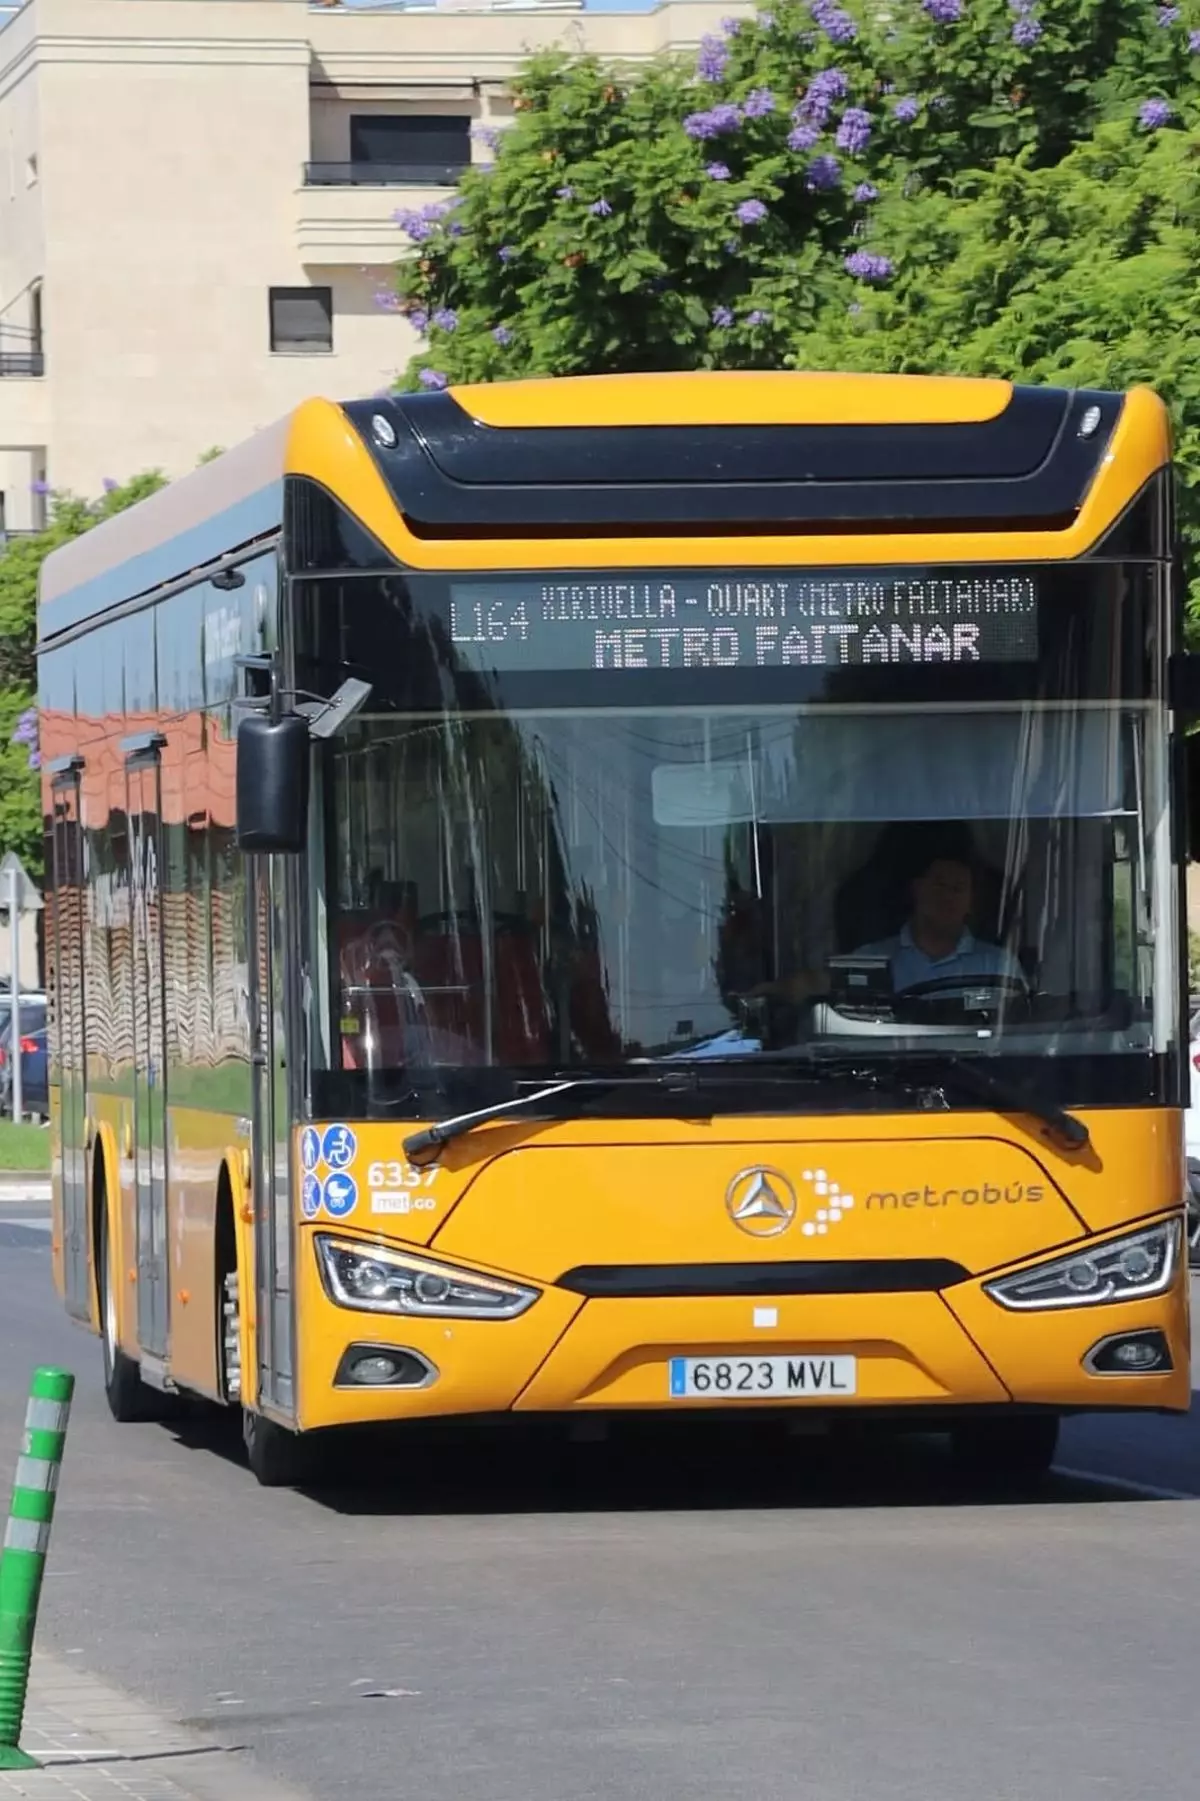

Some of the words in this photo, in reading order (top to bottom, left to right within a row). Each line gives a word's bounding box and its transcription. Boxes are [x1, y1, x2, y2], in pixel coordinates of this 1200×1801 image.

[542, 583, 676, 620] XIRIVELLA
[707, 582, 788, 617] QUART
[451, 601, 529, 642] L164
[595, 627, 740, 668] METRO
[755, 623, 980, 665] FAITANAR
[865, 1181, 1044, 1210] metrobús
[693, 1362, 774, 1391] 6823
[786, 1360, 847, 1390] MVL
